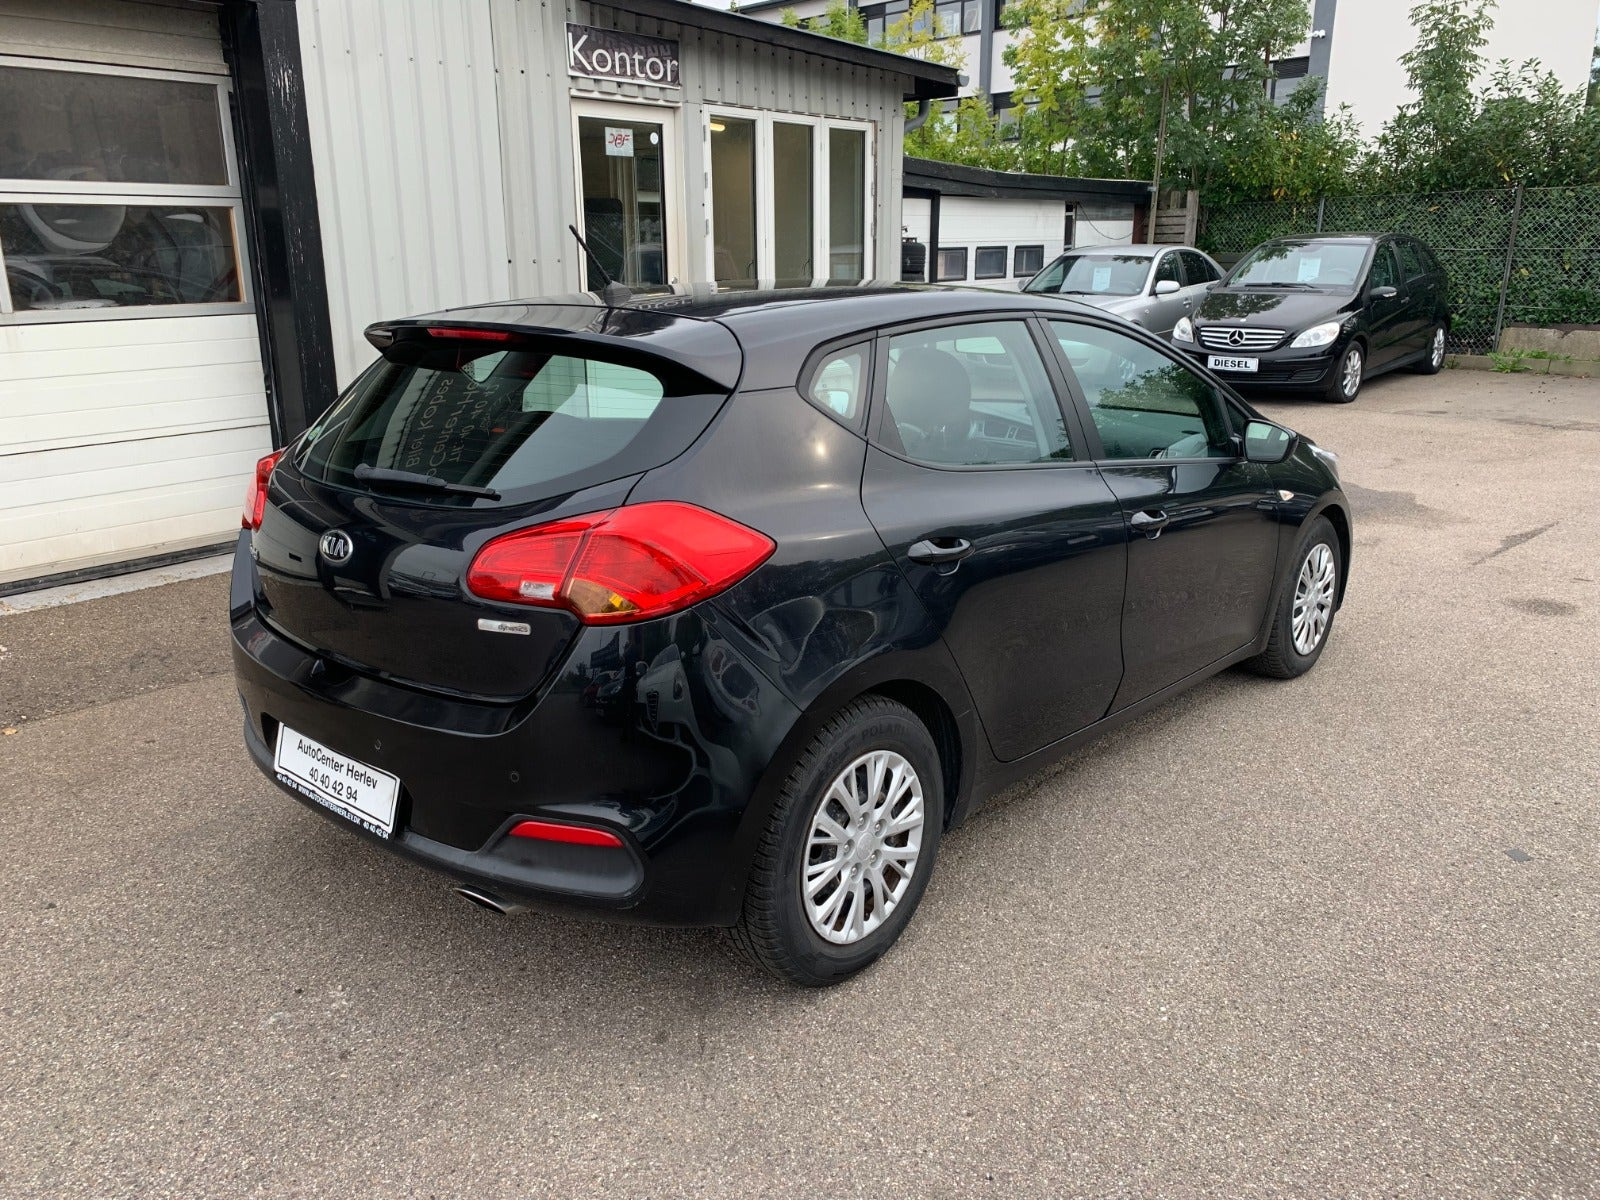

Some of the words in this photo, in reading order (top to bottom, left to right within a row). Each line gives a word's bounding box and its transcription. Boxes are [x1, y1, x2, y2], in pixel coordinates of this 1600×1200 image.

[567, 31, 679, 82] Kontor
[1214, 358, 1251, 368] DIESEL
[322, 535, 345, 557] KIA
[297, 738, 345, 774] AutoCenter
[346, 762, 378, 790] Herlev
[308, 766, 319, 783] 40
[319, 774, 330, 789] 40
[331, 780, 344, 797] 42
[346, 786, 358, 803] 94
